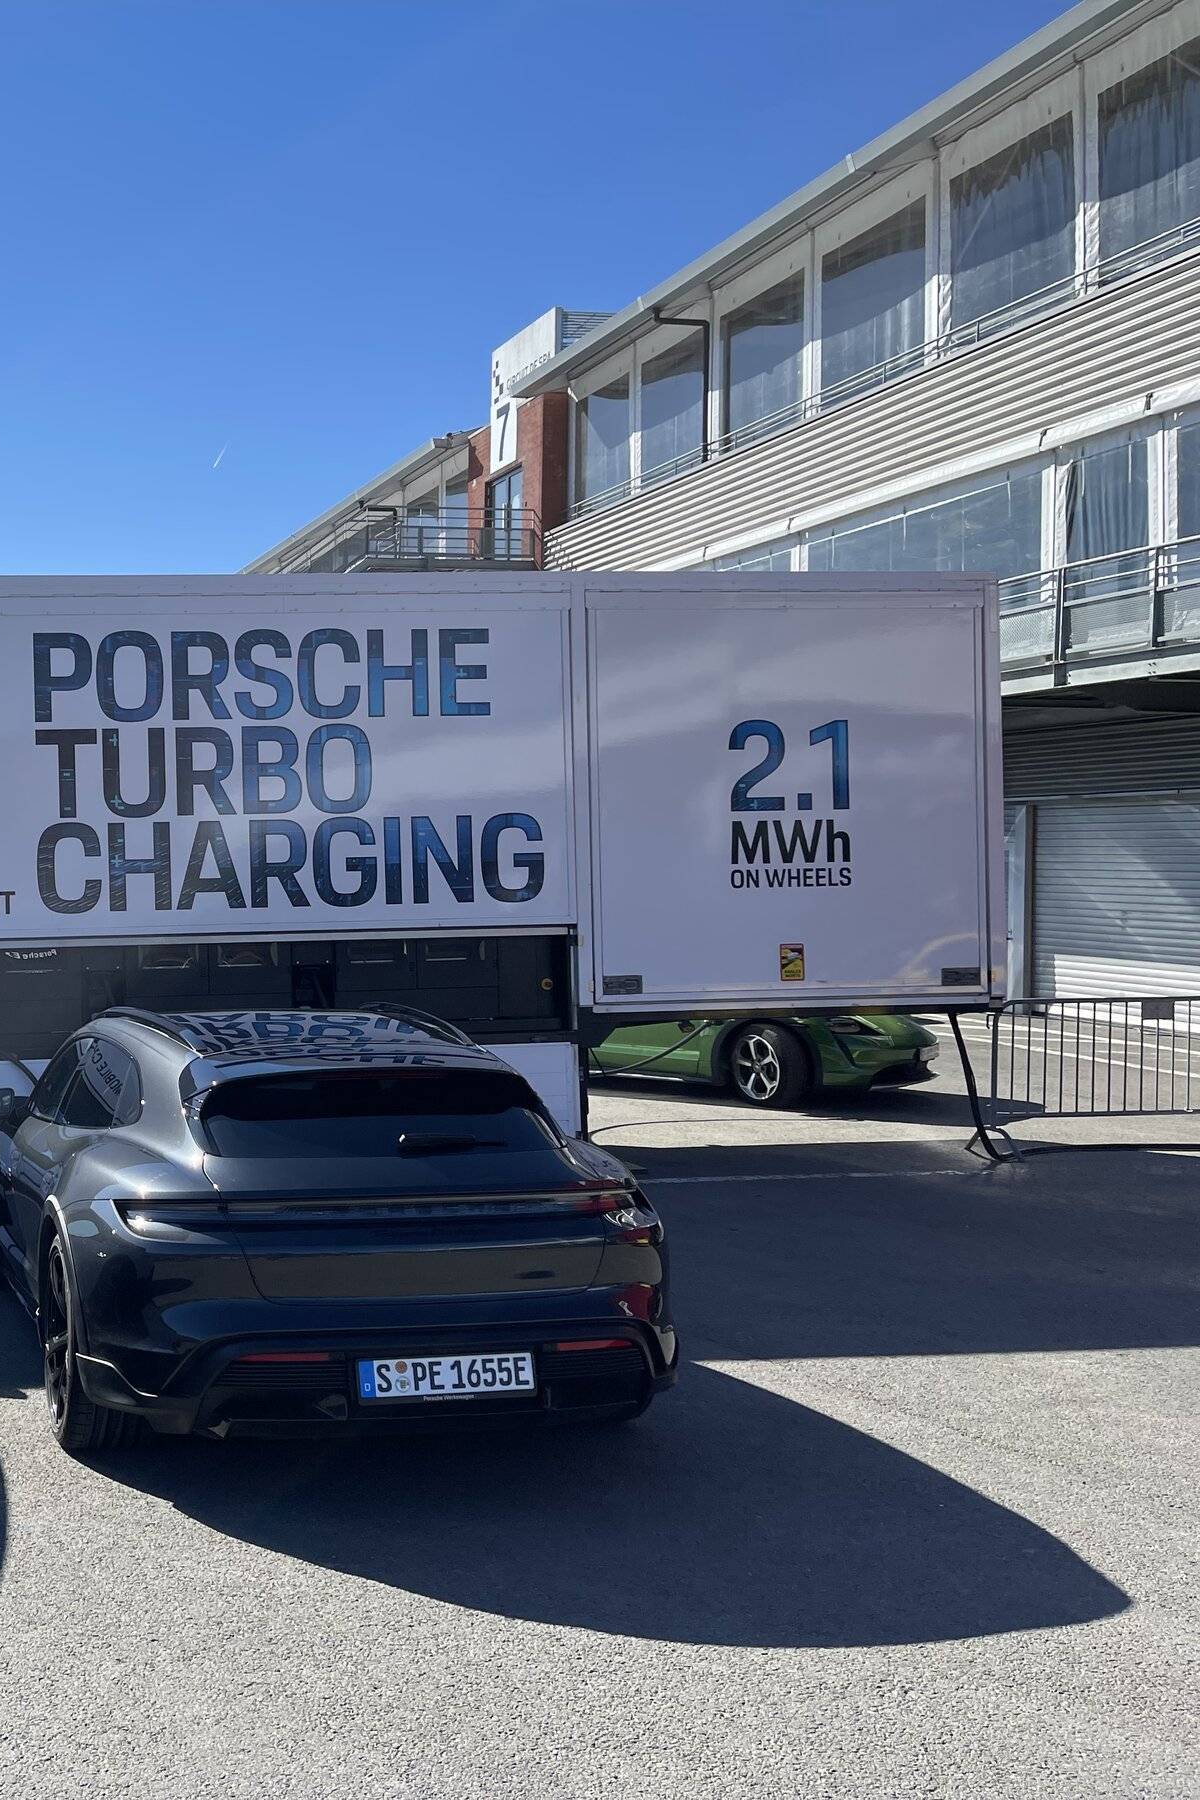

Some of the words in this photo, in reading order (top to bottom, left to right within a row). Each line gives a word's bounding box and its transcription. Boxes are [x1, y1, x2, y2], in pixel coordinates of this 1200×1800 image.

[496, 402, 510, 462] 7
[33, 628, 491, 722] PORSCHE
[34, 724, 373, 818] TURBO
[728, 719, 850, 811] 2.1
[36, 812, 546, 914] CHARGING
[730, 869, 760, 888] ON
[764, 867, 852, 888] WHEELS
[731, 819, 851, 865] MWh
[376, 1363, 393, 1393] S
[411, 1361, 445, 1391] PE
[450, 1356, 530, 1389] 1655E
